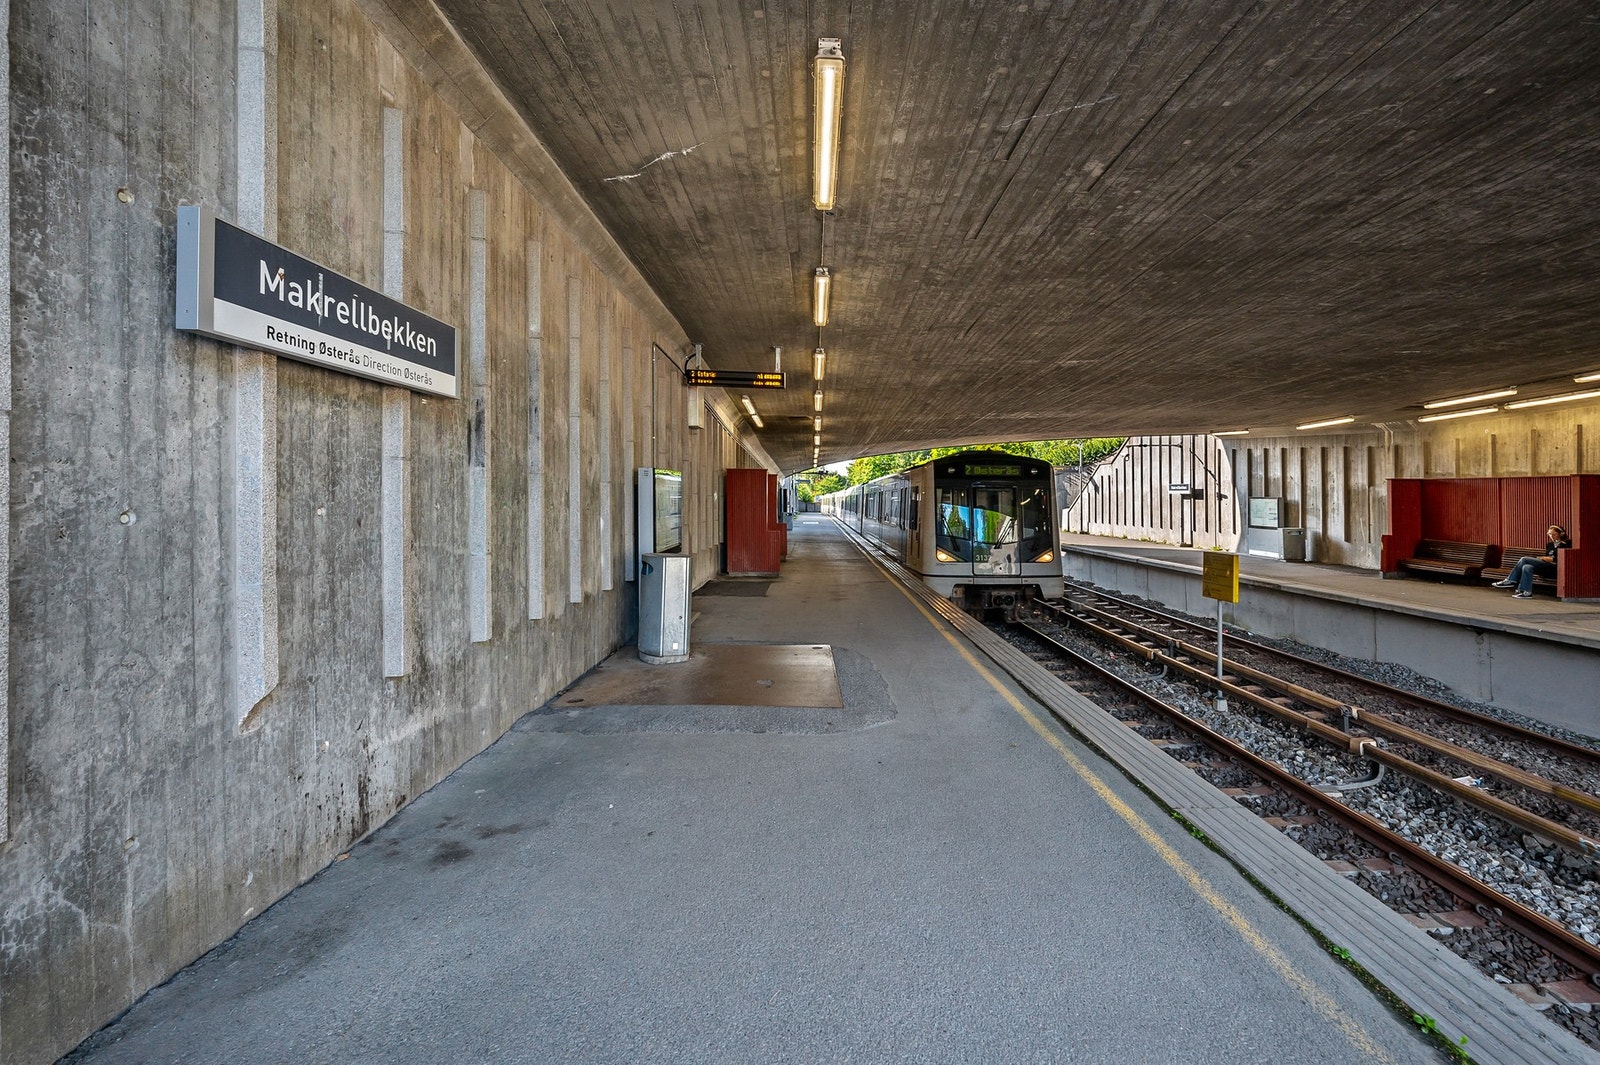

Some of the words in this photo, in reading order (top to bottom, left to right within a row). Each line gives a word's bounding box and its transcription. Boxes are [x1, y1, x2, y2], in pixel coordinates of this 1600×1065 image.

[260, 259, 437, 357] Makrellbekken
[266, 325, 315, 355] Retning
[319, 341, 360, 365] Østerås
[363, 355, 402, 377] Direction
[404, 367, 433, 386] Østerås
[965, 465, 971, 475] 2
